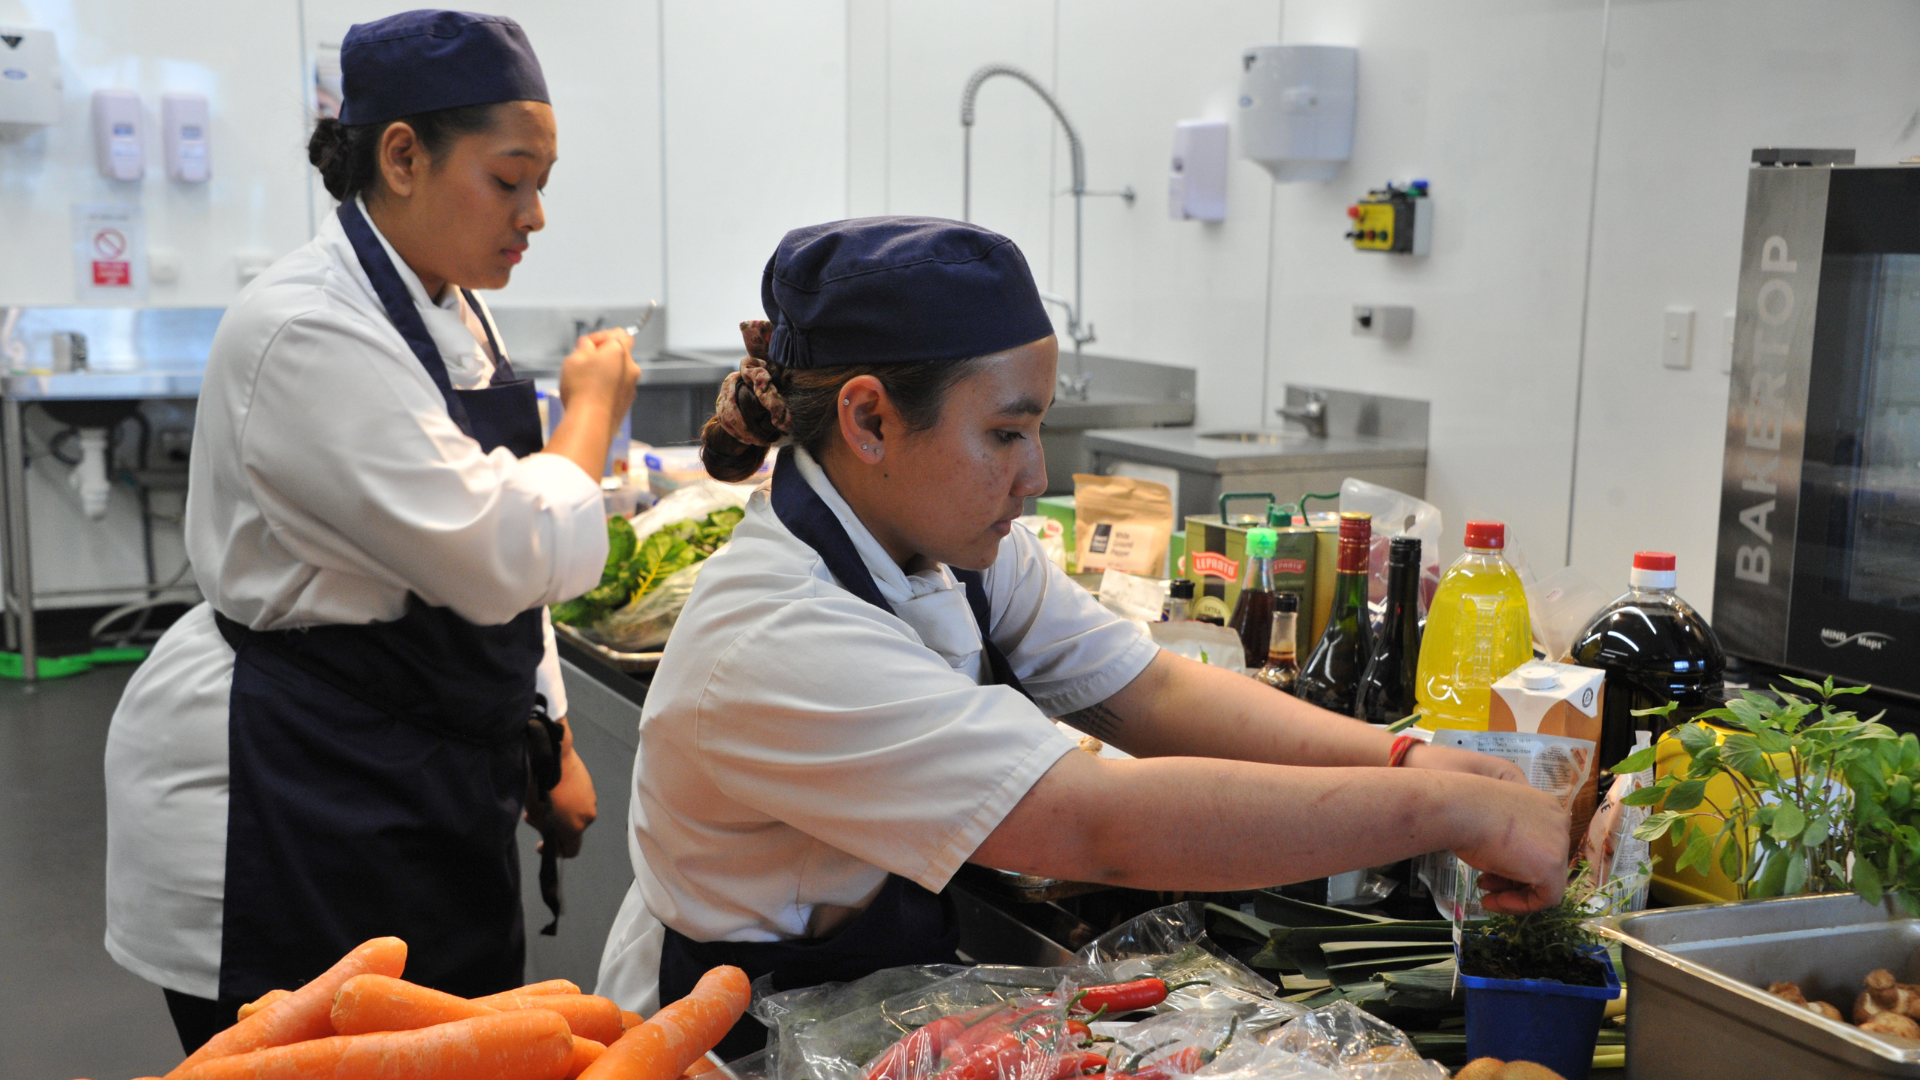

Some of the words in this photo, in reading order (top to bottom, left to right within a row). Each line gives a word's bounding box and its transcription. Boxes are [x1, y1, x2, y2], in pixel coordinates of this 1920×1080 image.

[1734, 234, 1798, 585] BAKERTOP
[1195, 557, 1235, 577] LEPANTO
[1204, 604, 1221, 614] EXTRA
[1821, 627, 1847, 641] MIND
[1857, 635, 1882, 651] Maps
